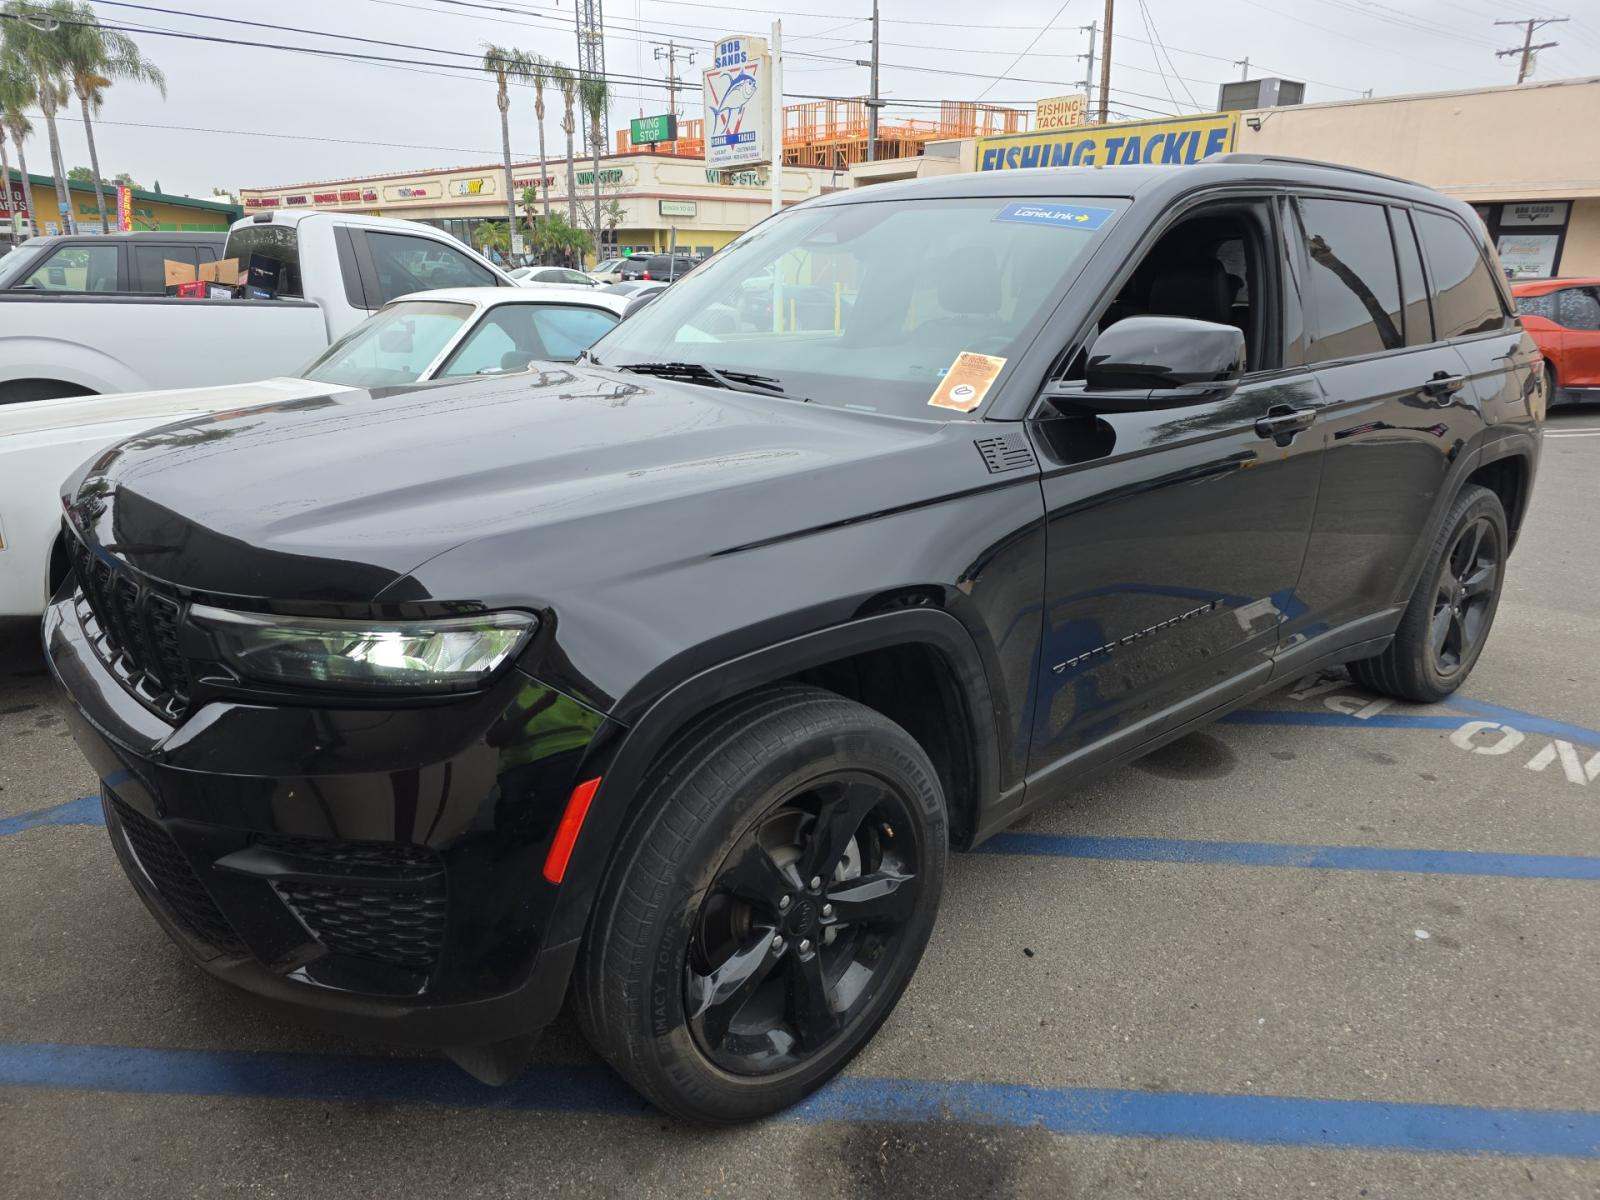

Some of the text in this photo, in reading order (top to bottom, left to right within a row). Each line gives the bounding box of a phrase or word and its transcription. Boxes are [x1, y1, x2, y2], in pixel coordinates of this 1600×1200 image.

[720, 40, 740, 55] BOB
[715, 51, 747, 69] SANDS
[1037, 100, 1079, 116] FISHING
[639, 117, 660, 130] WING
[1037, 113, 1076, 128] TACKLE
[640, 129, 660, 141] STOP
[982, 128, 1228, 171] FISHING TACKLE
[512, 176, 555, 188] DENTISY
[657, 926, 676, 974] TOUR
